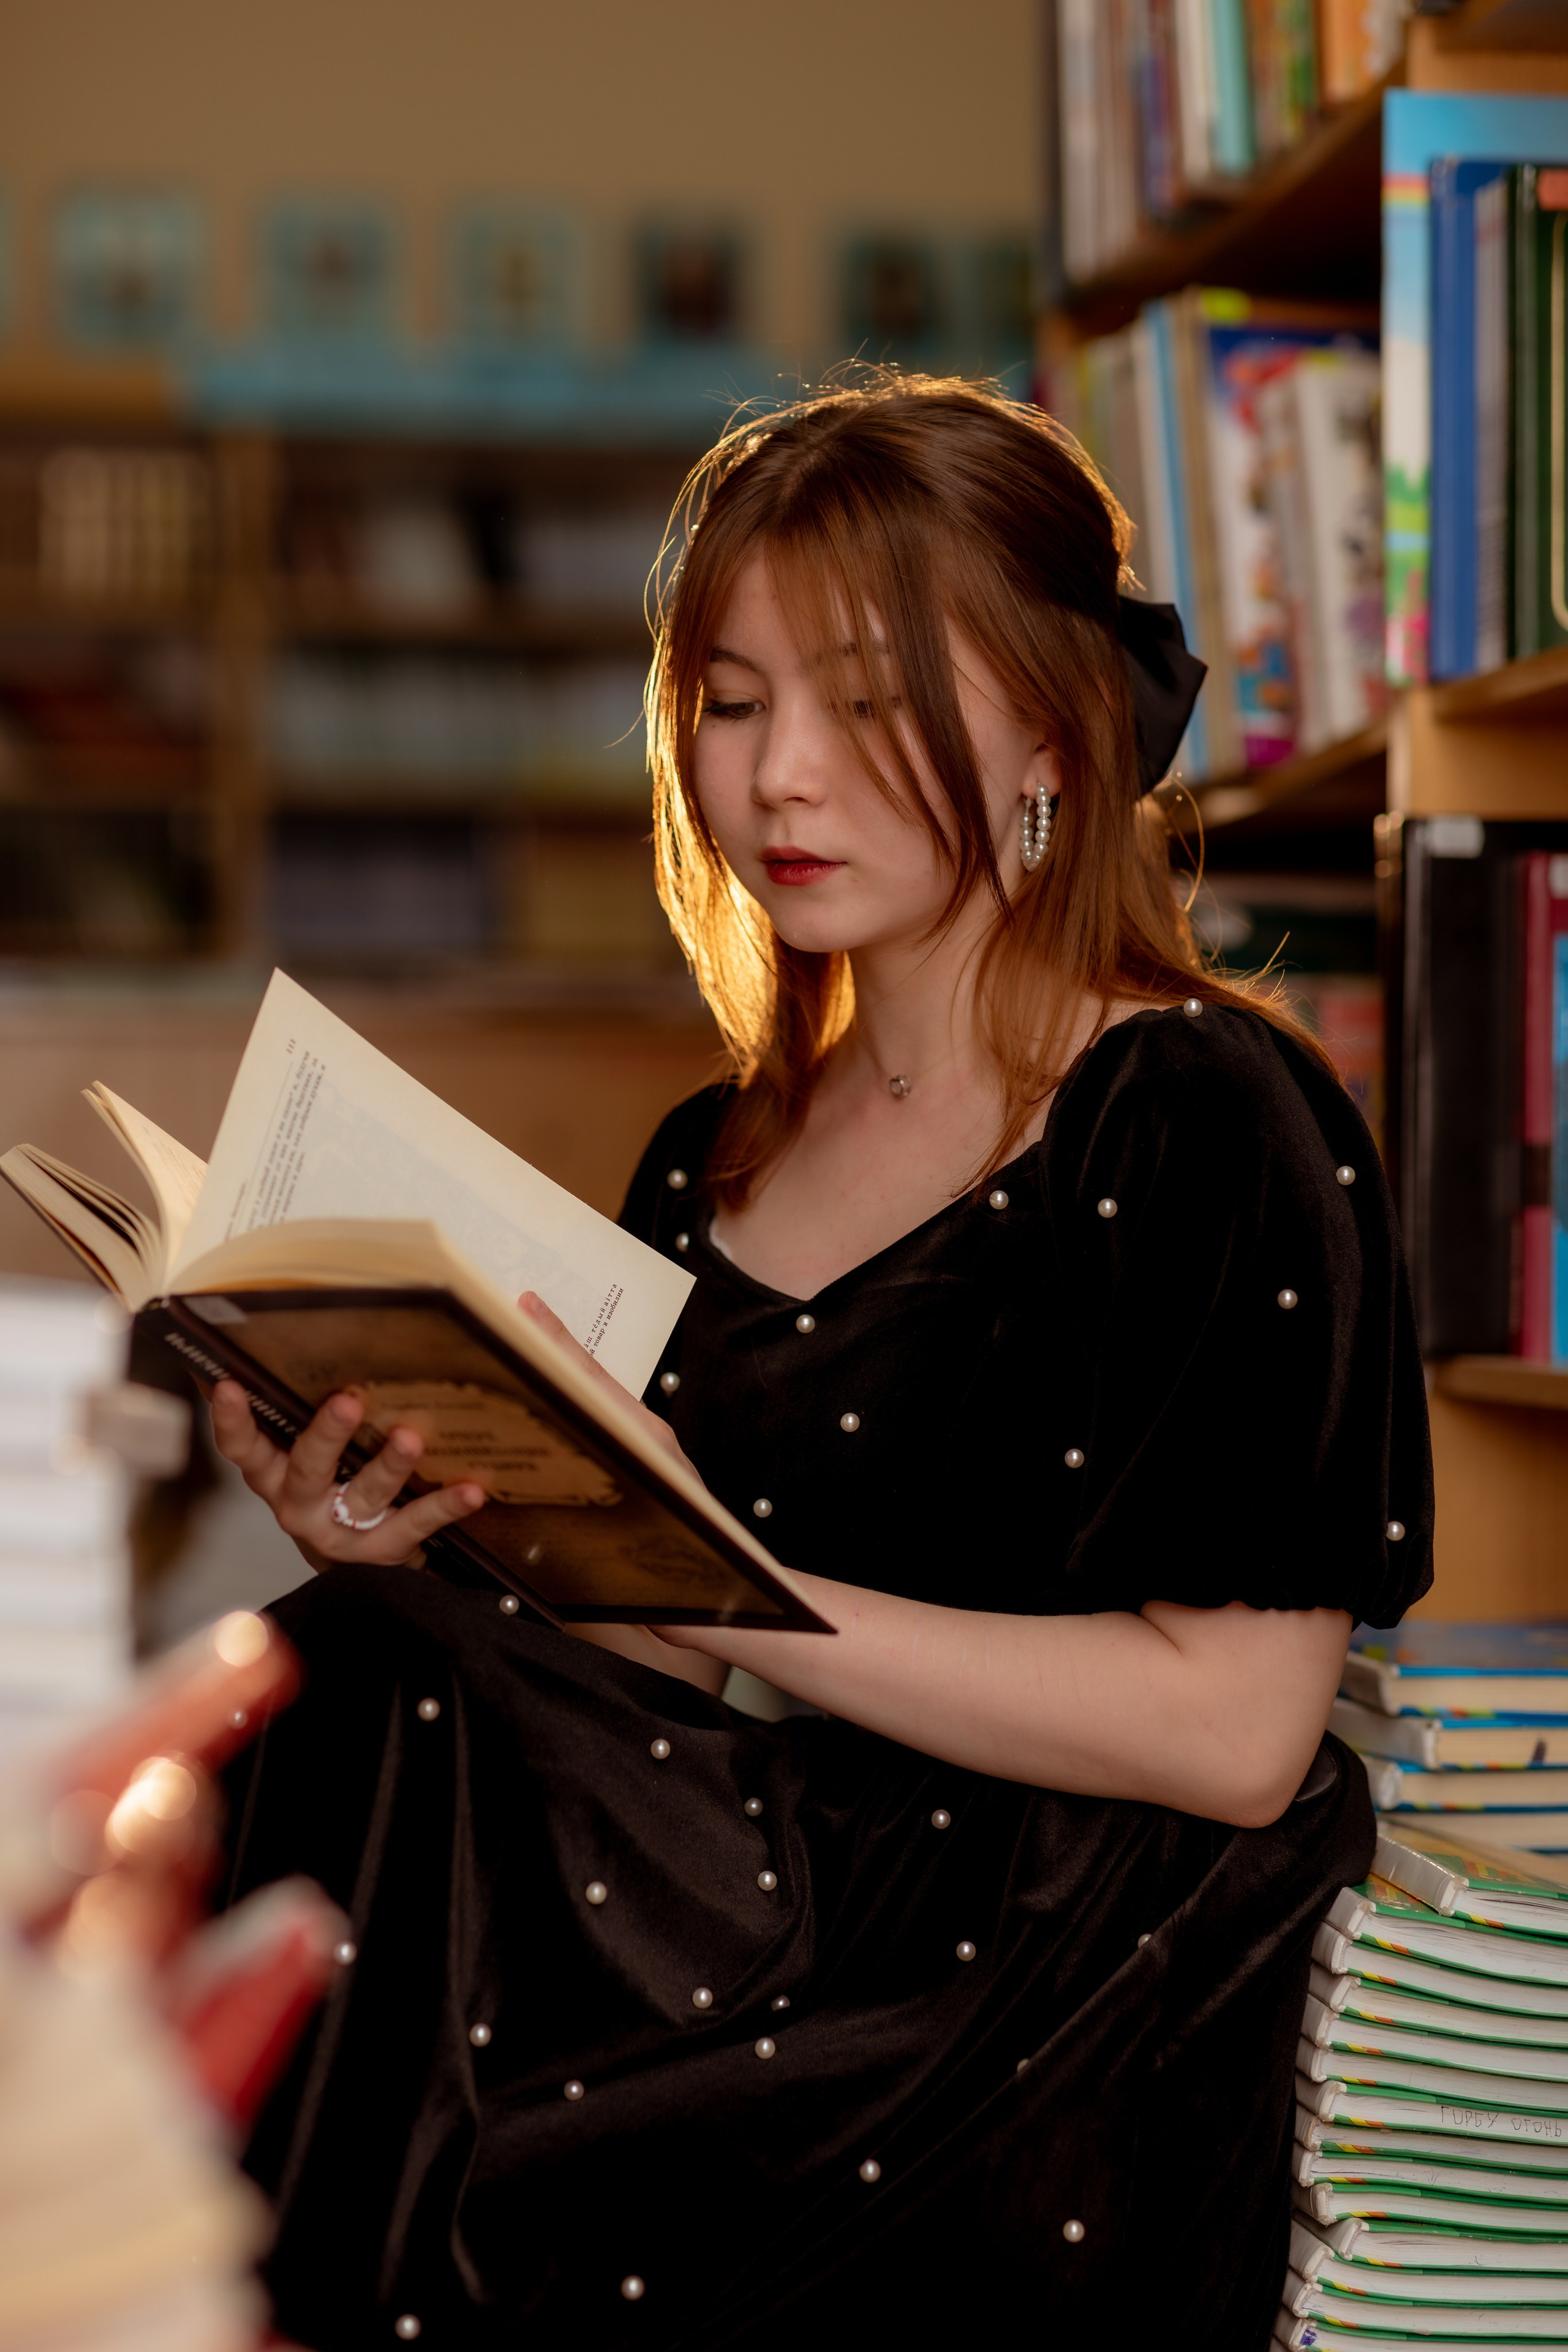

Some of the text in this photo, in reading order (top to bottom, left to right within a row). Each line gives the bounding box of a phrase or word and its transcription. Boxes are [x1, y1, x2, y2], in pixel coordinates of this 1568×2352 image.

[594, 1328, 605, 1347] товар
[606, 1287, 624, 1320] изобилии
[583, 1336, 592, 1348] âш
